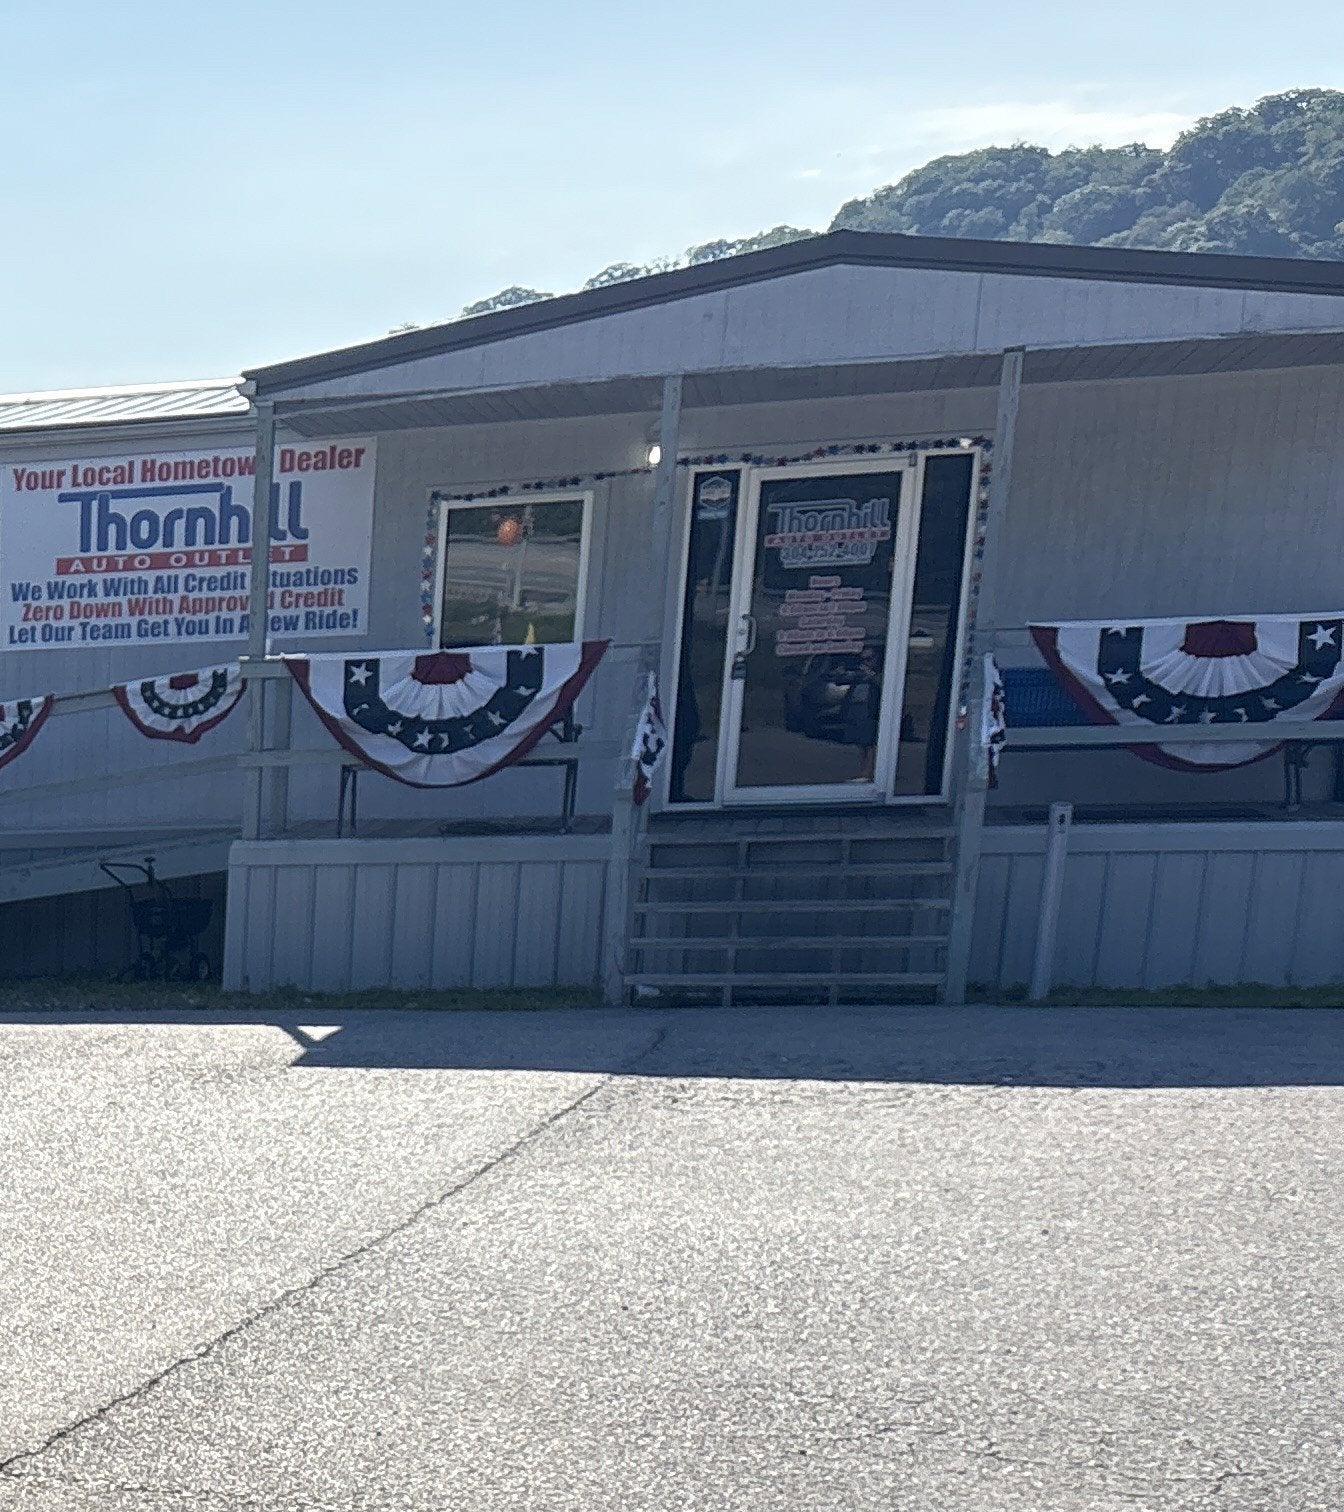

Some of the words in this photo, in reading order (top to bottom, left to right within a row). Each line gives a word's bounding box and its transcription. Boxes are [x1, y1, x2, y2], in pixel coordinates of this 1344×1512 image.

[13, 467, 66, 492] Your
[71, 459, 135, 488] Local
[140, 454, 256, 483] Hometow
[279, 444, 366, 473] Dealer
[57, 480, 308, 553] Thornhll
[69, 555, 152, 573] AUTO
[169, 546, 295, 567] OUTLT
[10, 582, 43, 601] We
[46, 579, 98, 600] Work
[103, 575, 149, 597] With
[153, 573, 179, 595] All
[184, 570, 247, 593] Credit
[271, 566, 359, 588] tuations
[22, 602, 64, 622] Zero
[69, 600, 122, 619] Down
[127, 596, 173, 617] With
[178, 590, 275, 616] Approvd
[280, 587, 345, 609] Credit
[9, 625, 37, 644] Let
[42, 623, 75, 642] Our
[79, 621, 132, 641] Team
[136, 618, 170, 638] Get
[174, 617, 210, 636] You
[214, 615, 234, 634] In
[238, 613, 250, 633] A
[270, 614, 300, 632] ew
[304, 608, 360, 631] Ride!
